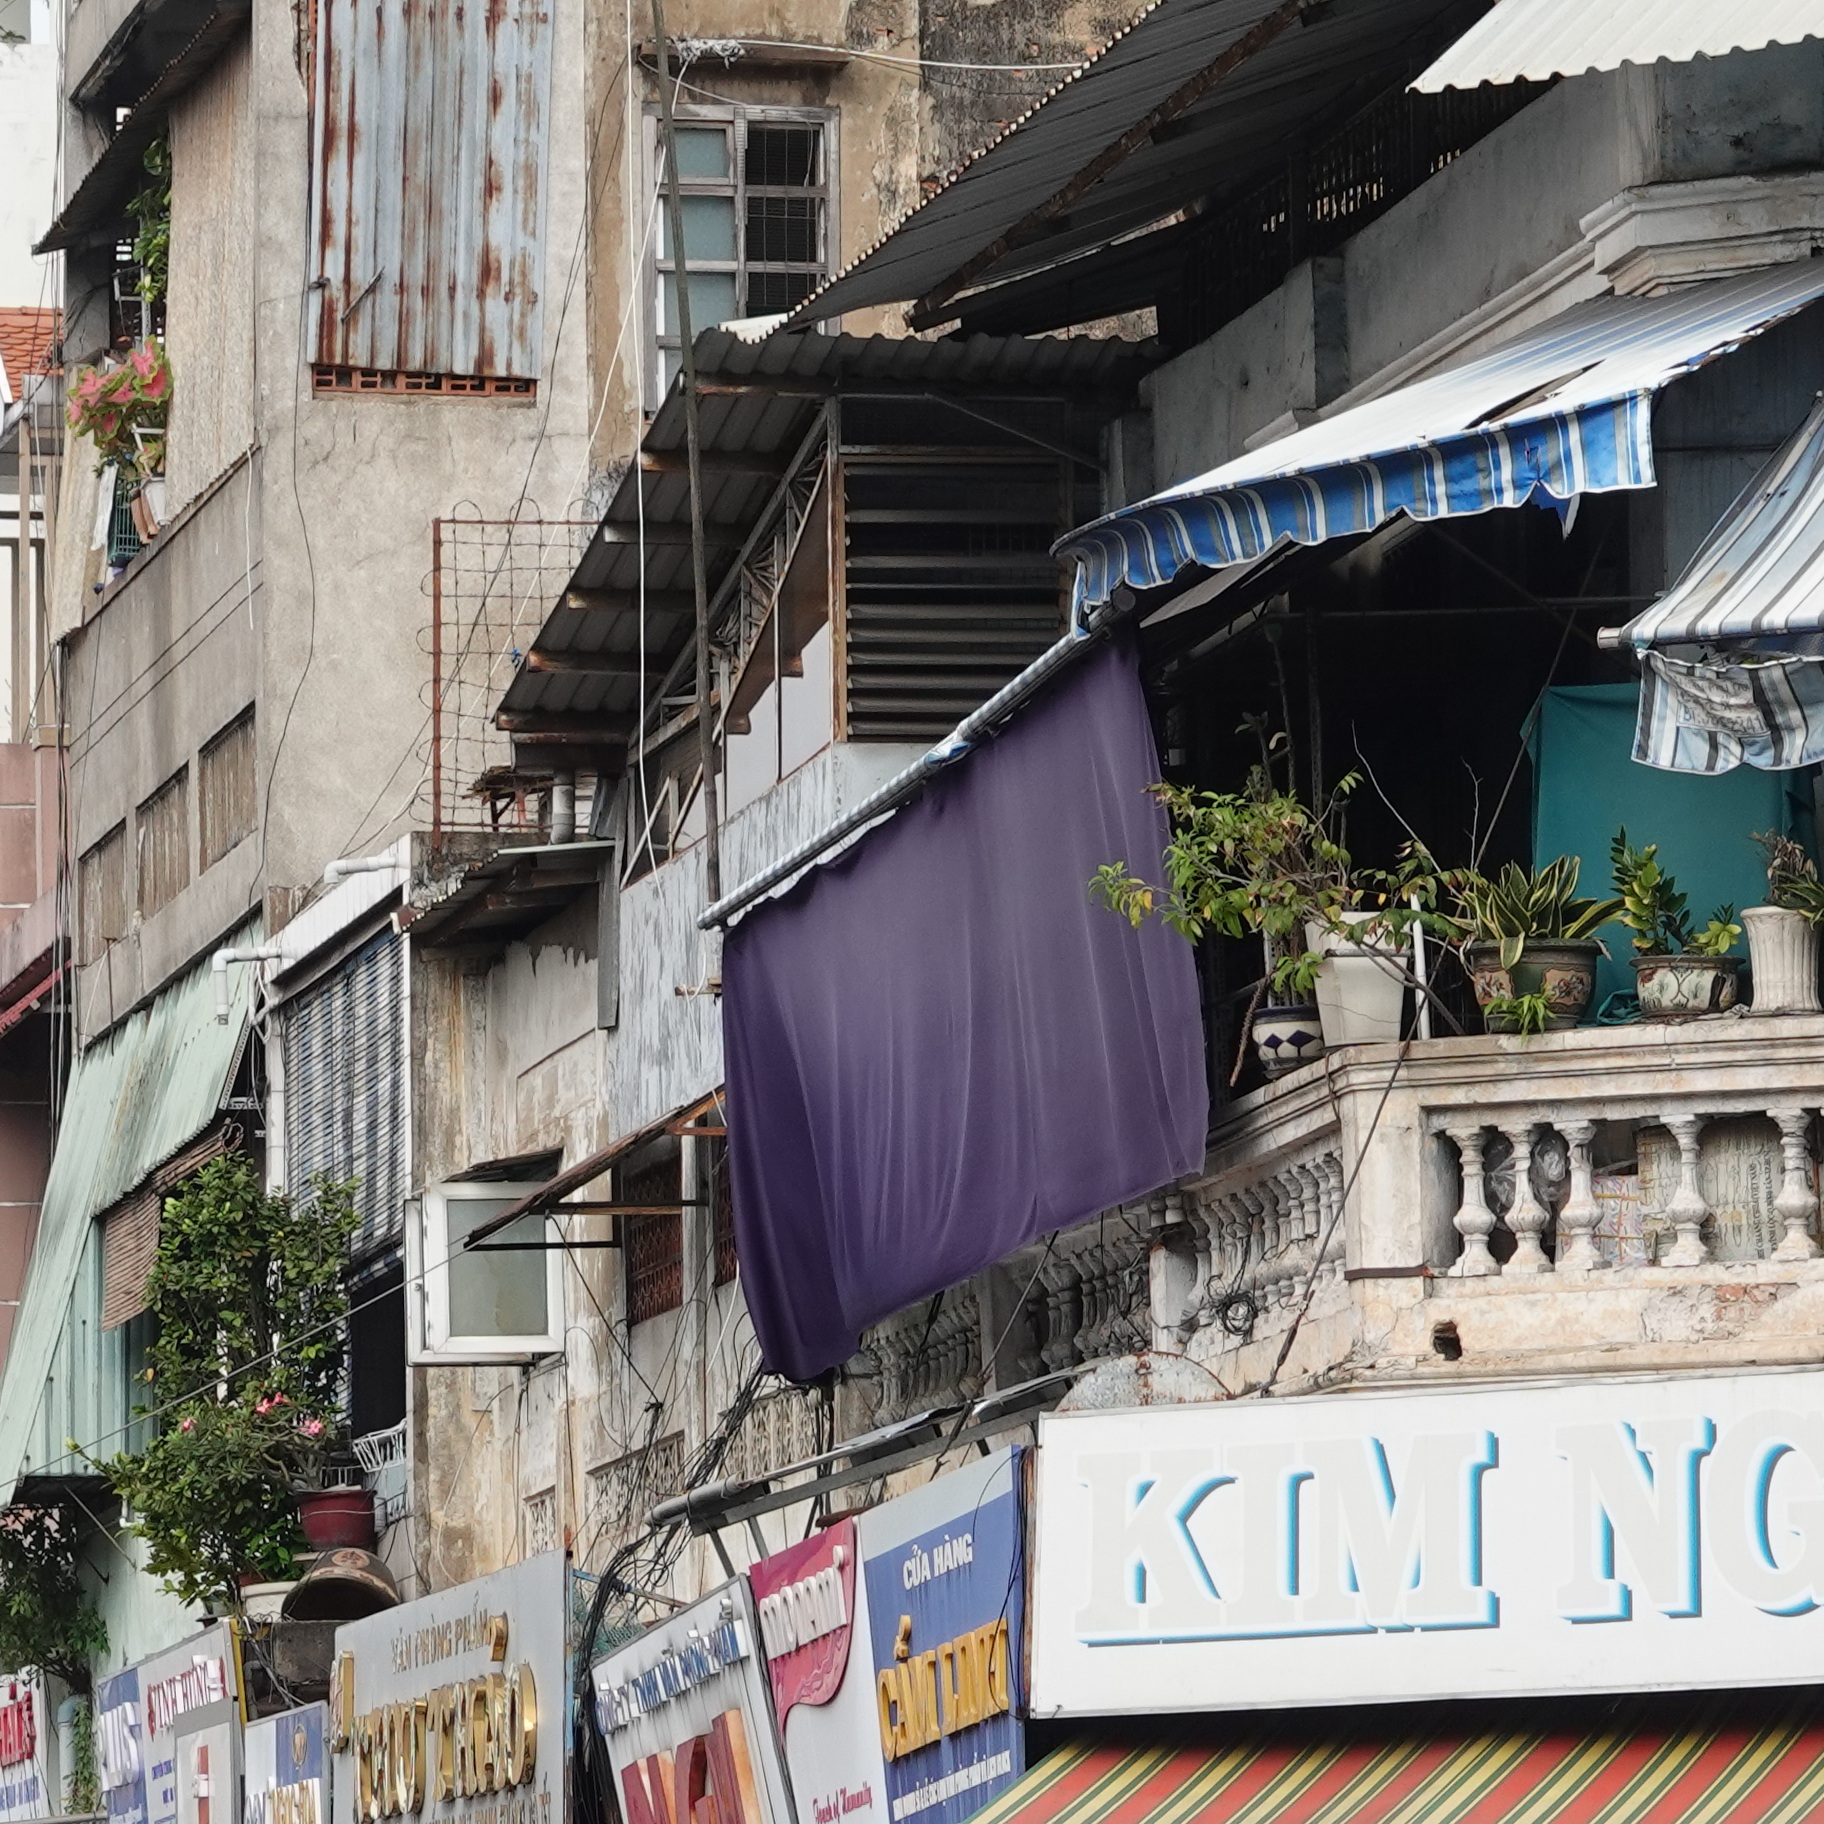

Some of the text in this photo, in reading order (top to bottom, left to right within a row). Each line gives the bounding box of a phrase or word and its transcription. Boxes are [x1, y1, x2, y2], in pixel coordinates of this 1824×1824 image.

[903, 1532, 973, 1591] CỬA HÀNG
[1075, 1427, 1500, 1648] KIM
[415, 1611, 452, 1668] PHÒNG
[877, 1613, 1010, 1764] CẨM LINH
